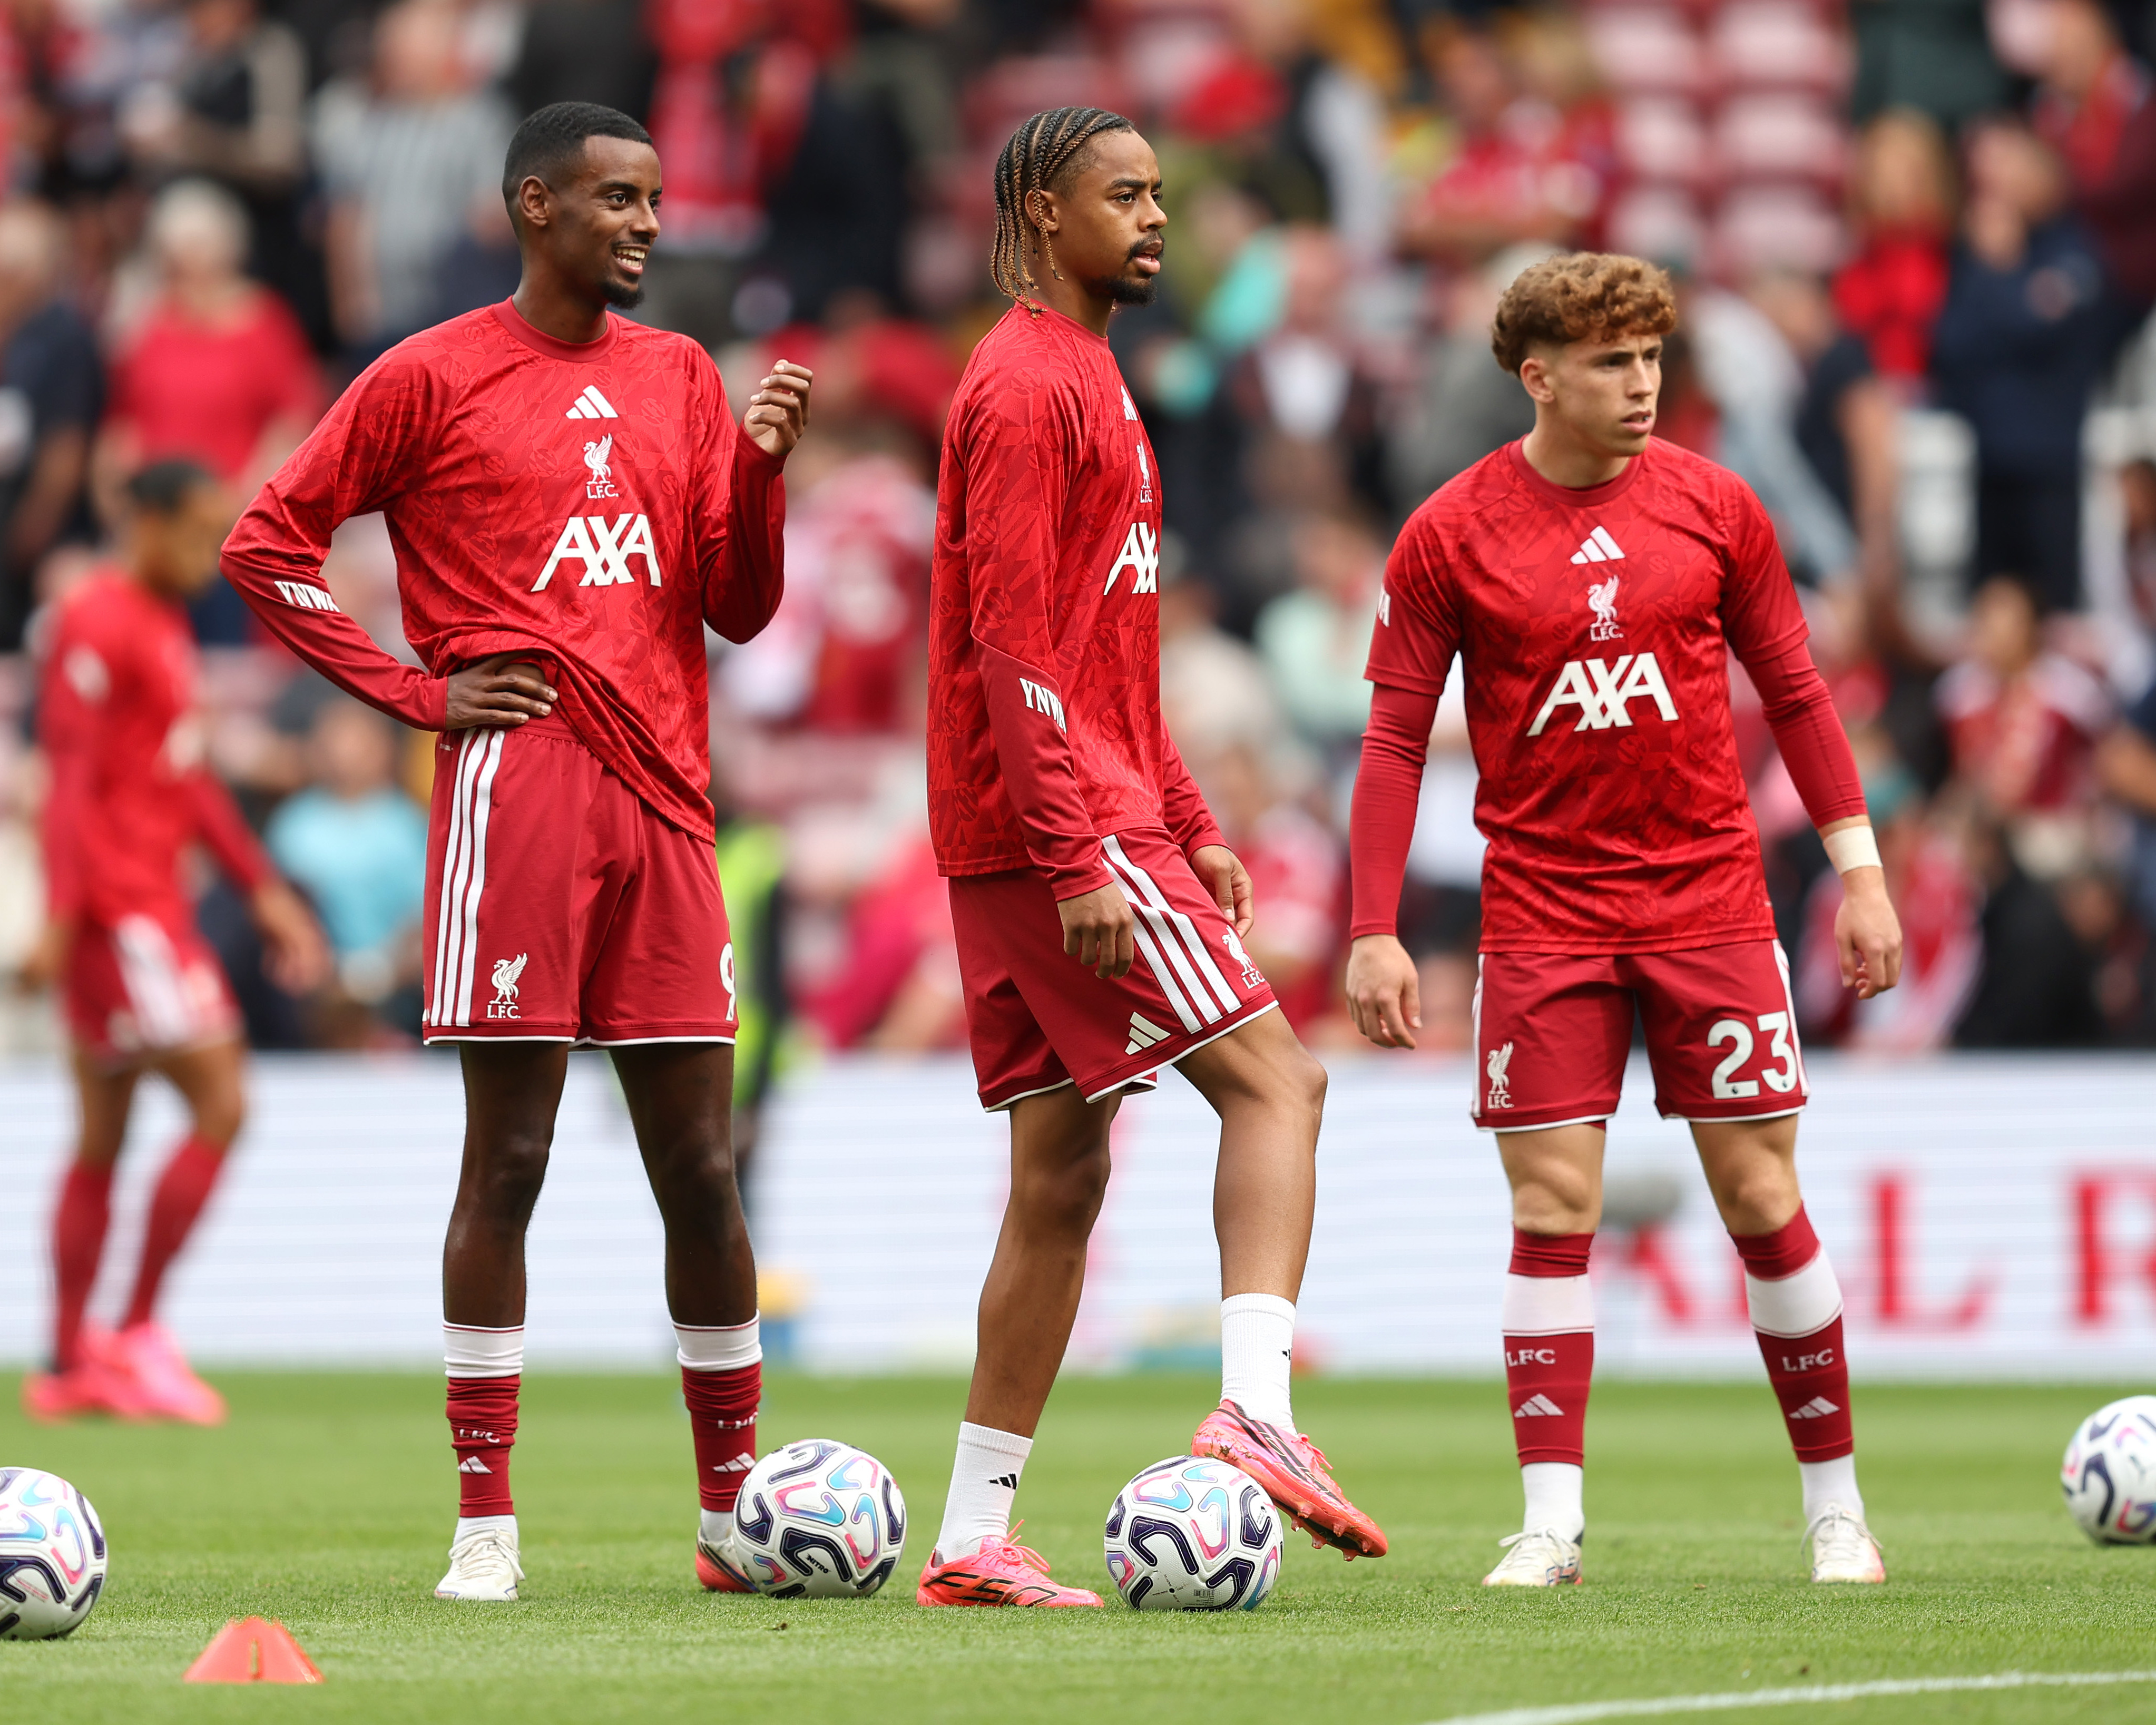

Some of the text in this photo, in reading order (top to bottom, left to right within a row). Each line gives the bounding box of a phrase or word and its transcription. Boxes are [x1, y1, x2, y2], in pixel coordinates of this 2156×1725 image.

[586, 484, 619, 499] L.F.C.
[530, 513, 662, 592] AXA
[1103, 522, 1159, 596] AX
[274, 581, 340, 612] YNWA
[1019, 678, 1066, 734] YNWA
[1526, 652, 1679, 737] AXA
[486, 1005, 521, 1019] L.F.C.
[1707, 1010, 1798, 1100] 23
[1506, 1348, 1556, 1367] LFC
[1782, 1348, 1834, 1372] LFC
[806, 1553, 829, 1573] NITRO
